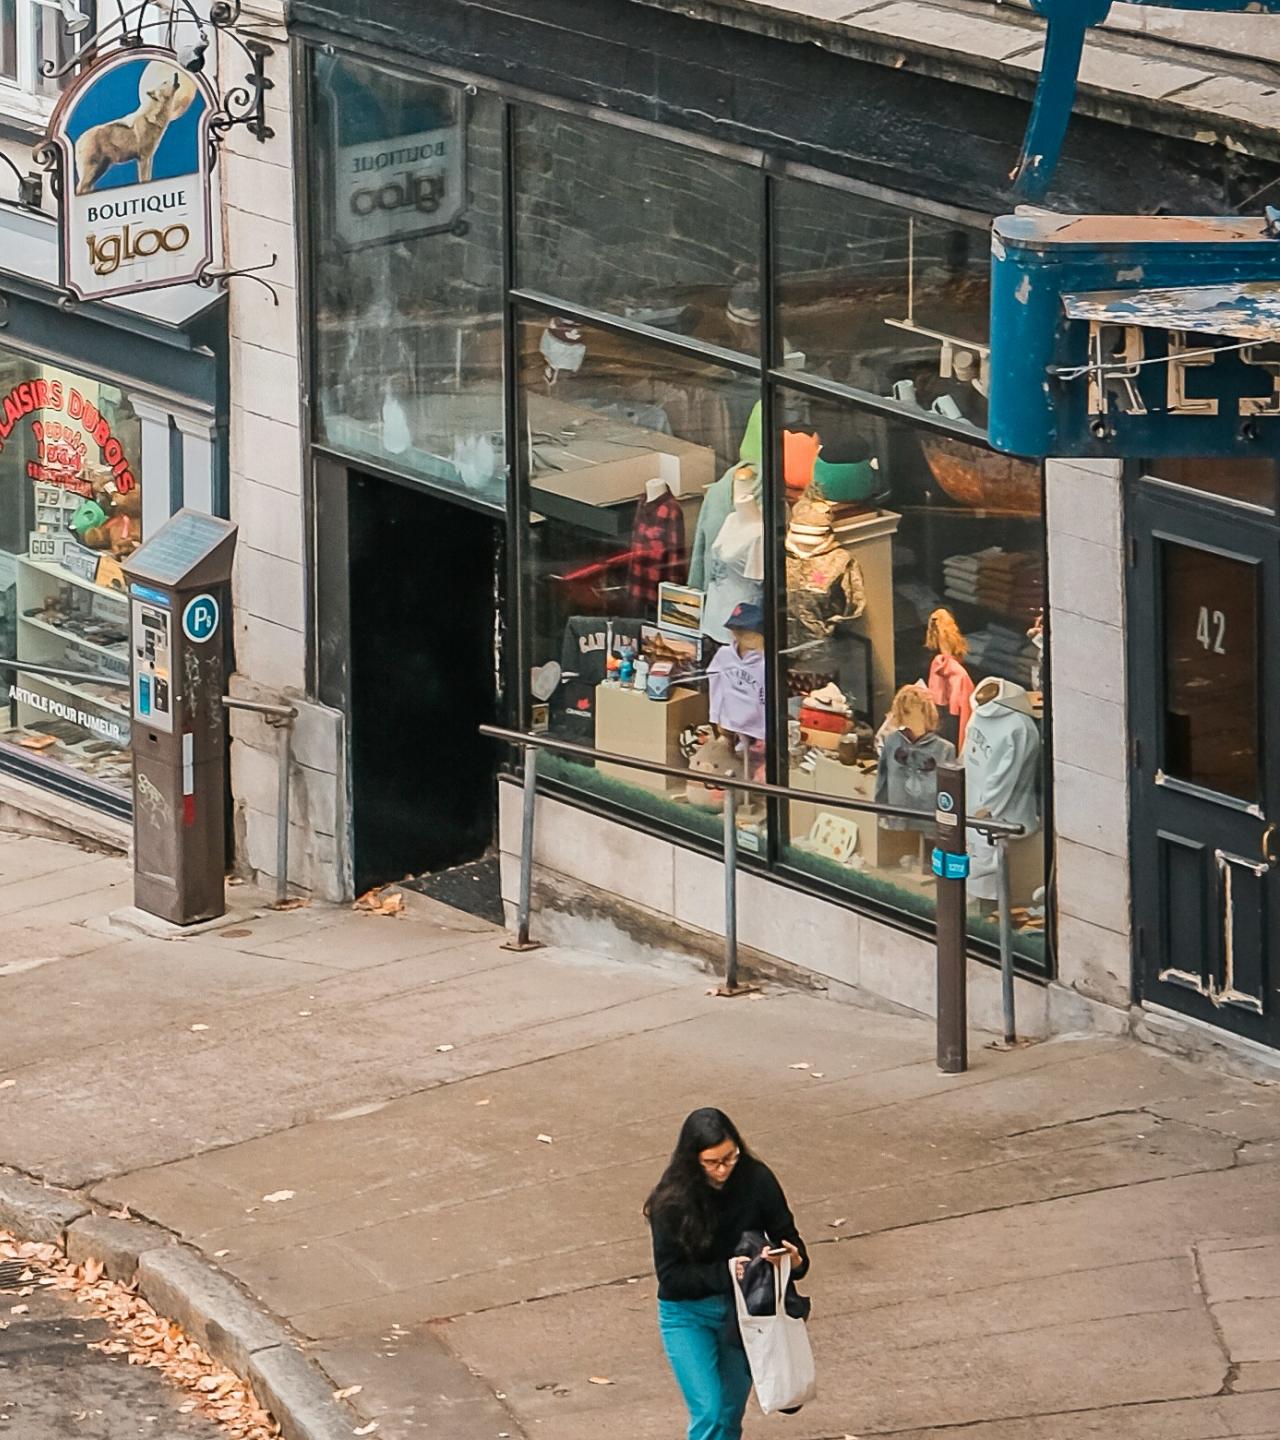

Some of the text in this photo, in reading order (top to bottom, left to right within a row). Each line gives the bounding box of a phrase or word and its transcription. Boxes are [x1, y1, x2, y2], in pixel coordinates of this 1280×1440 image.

[87, 191, 187, 223] BOUTIQUE
[86, 223, 190, 276] igloo
[67, 387, 136, 495] DUBOIS
[1196, 605, 1226, 655] 42
[8, 684, 120, 740] ARTICLE POUR FUMEUR
